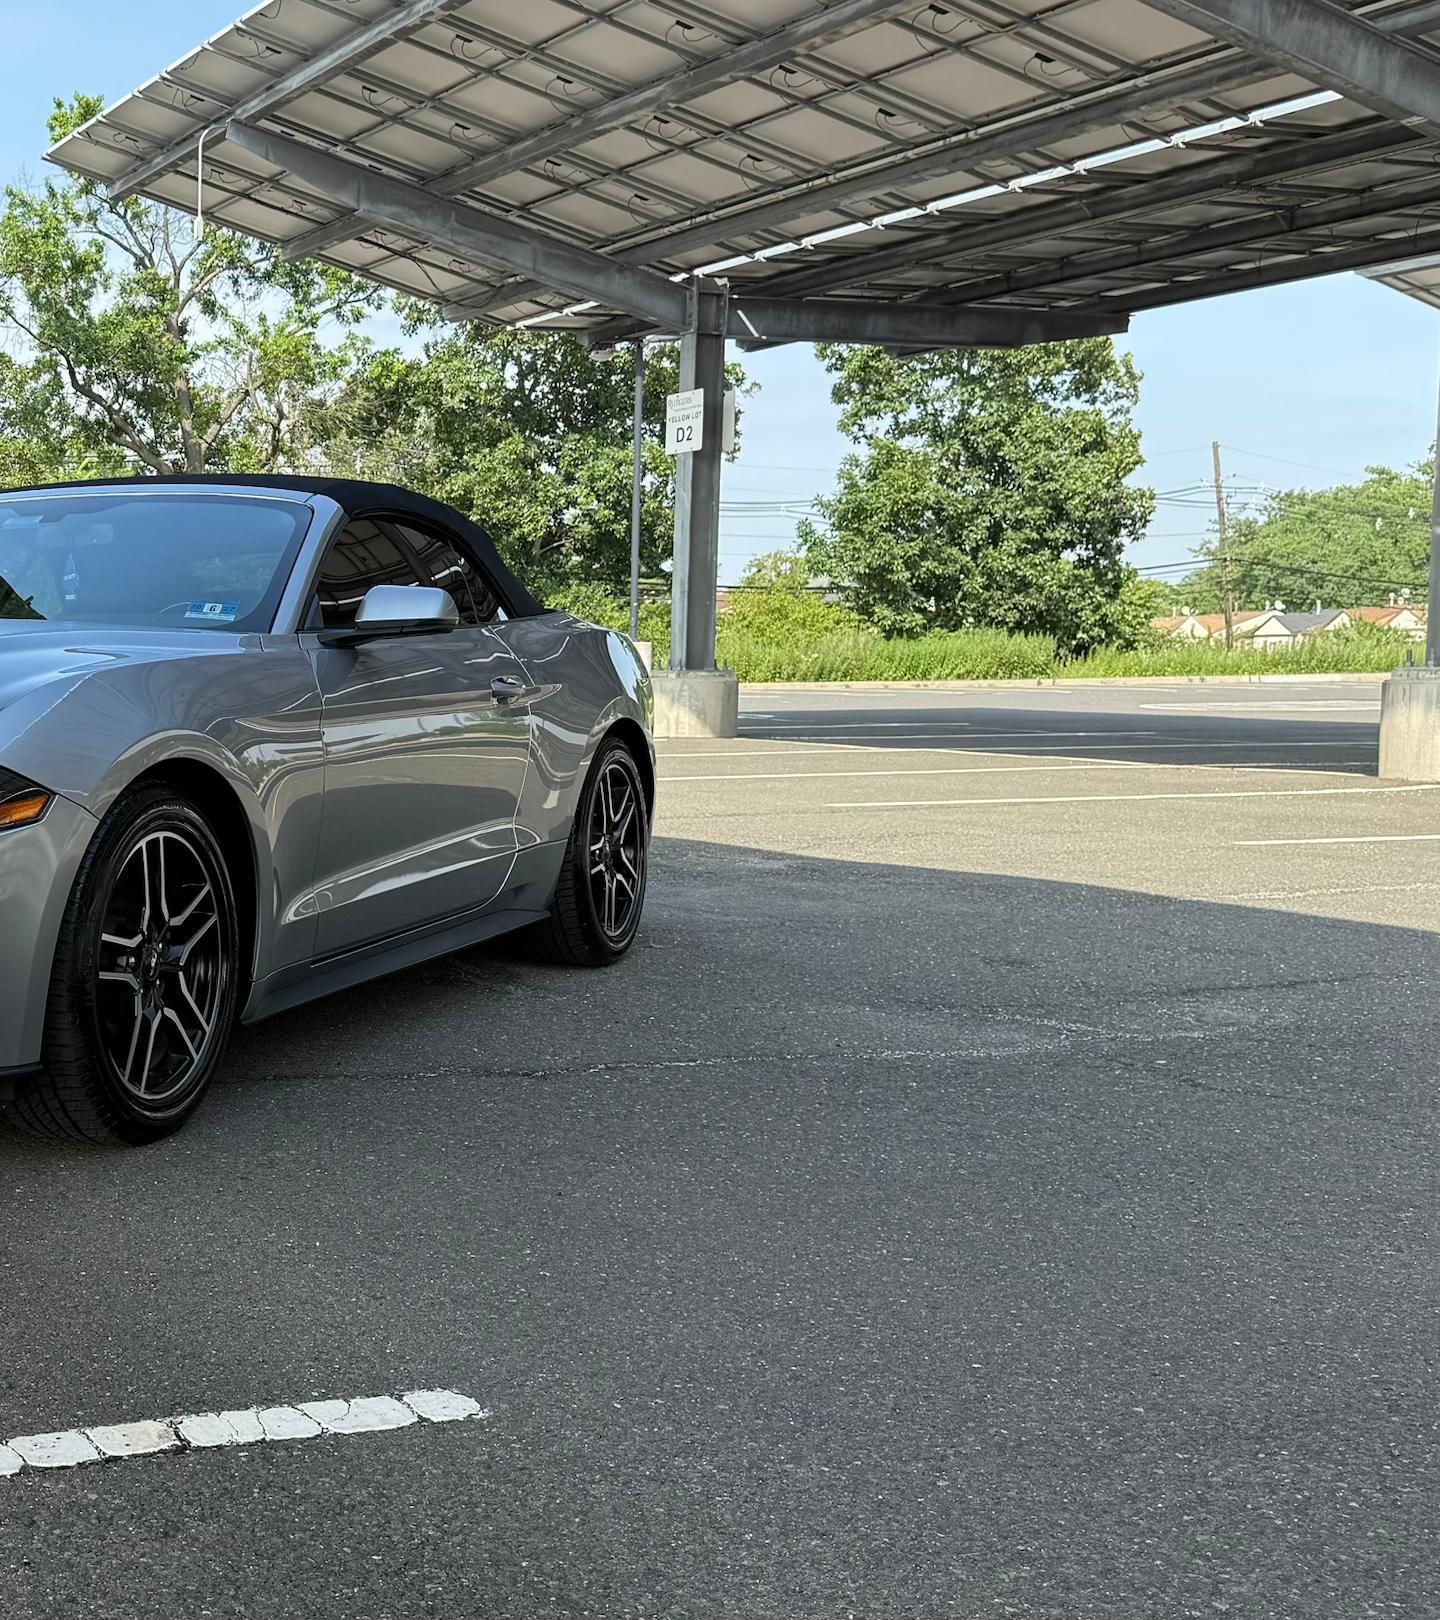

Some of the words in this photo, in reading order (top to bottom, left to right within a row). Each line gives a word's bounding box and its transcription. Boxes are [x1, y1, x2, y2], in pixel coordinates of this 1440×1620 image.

[668, 397, 692, 410] RUTERS
[668, 413, 691, 423] YELLOW
[676, 425, 693, 442] D2
